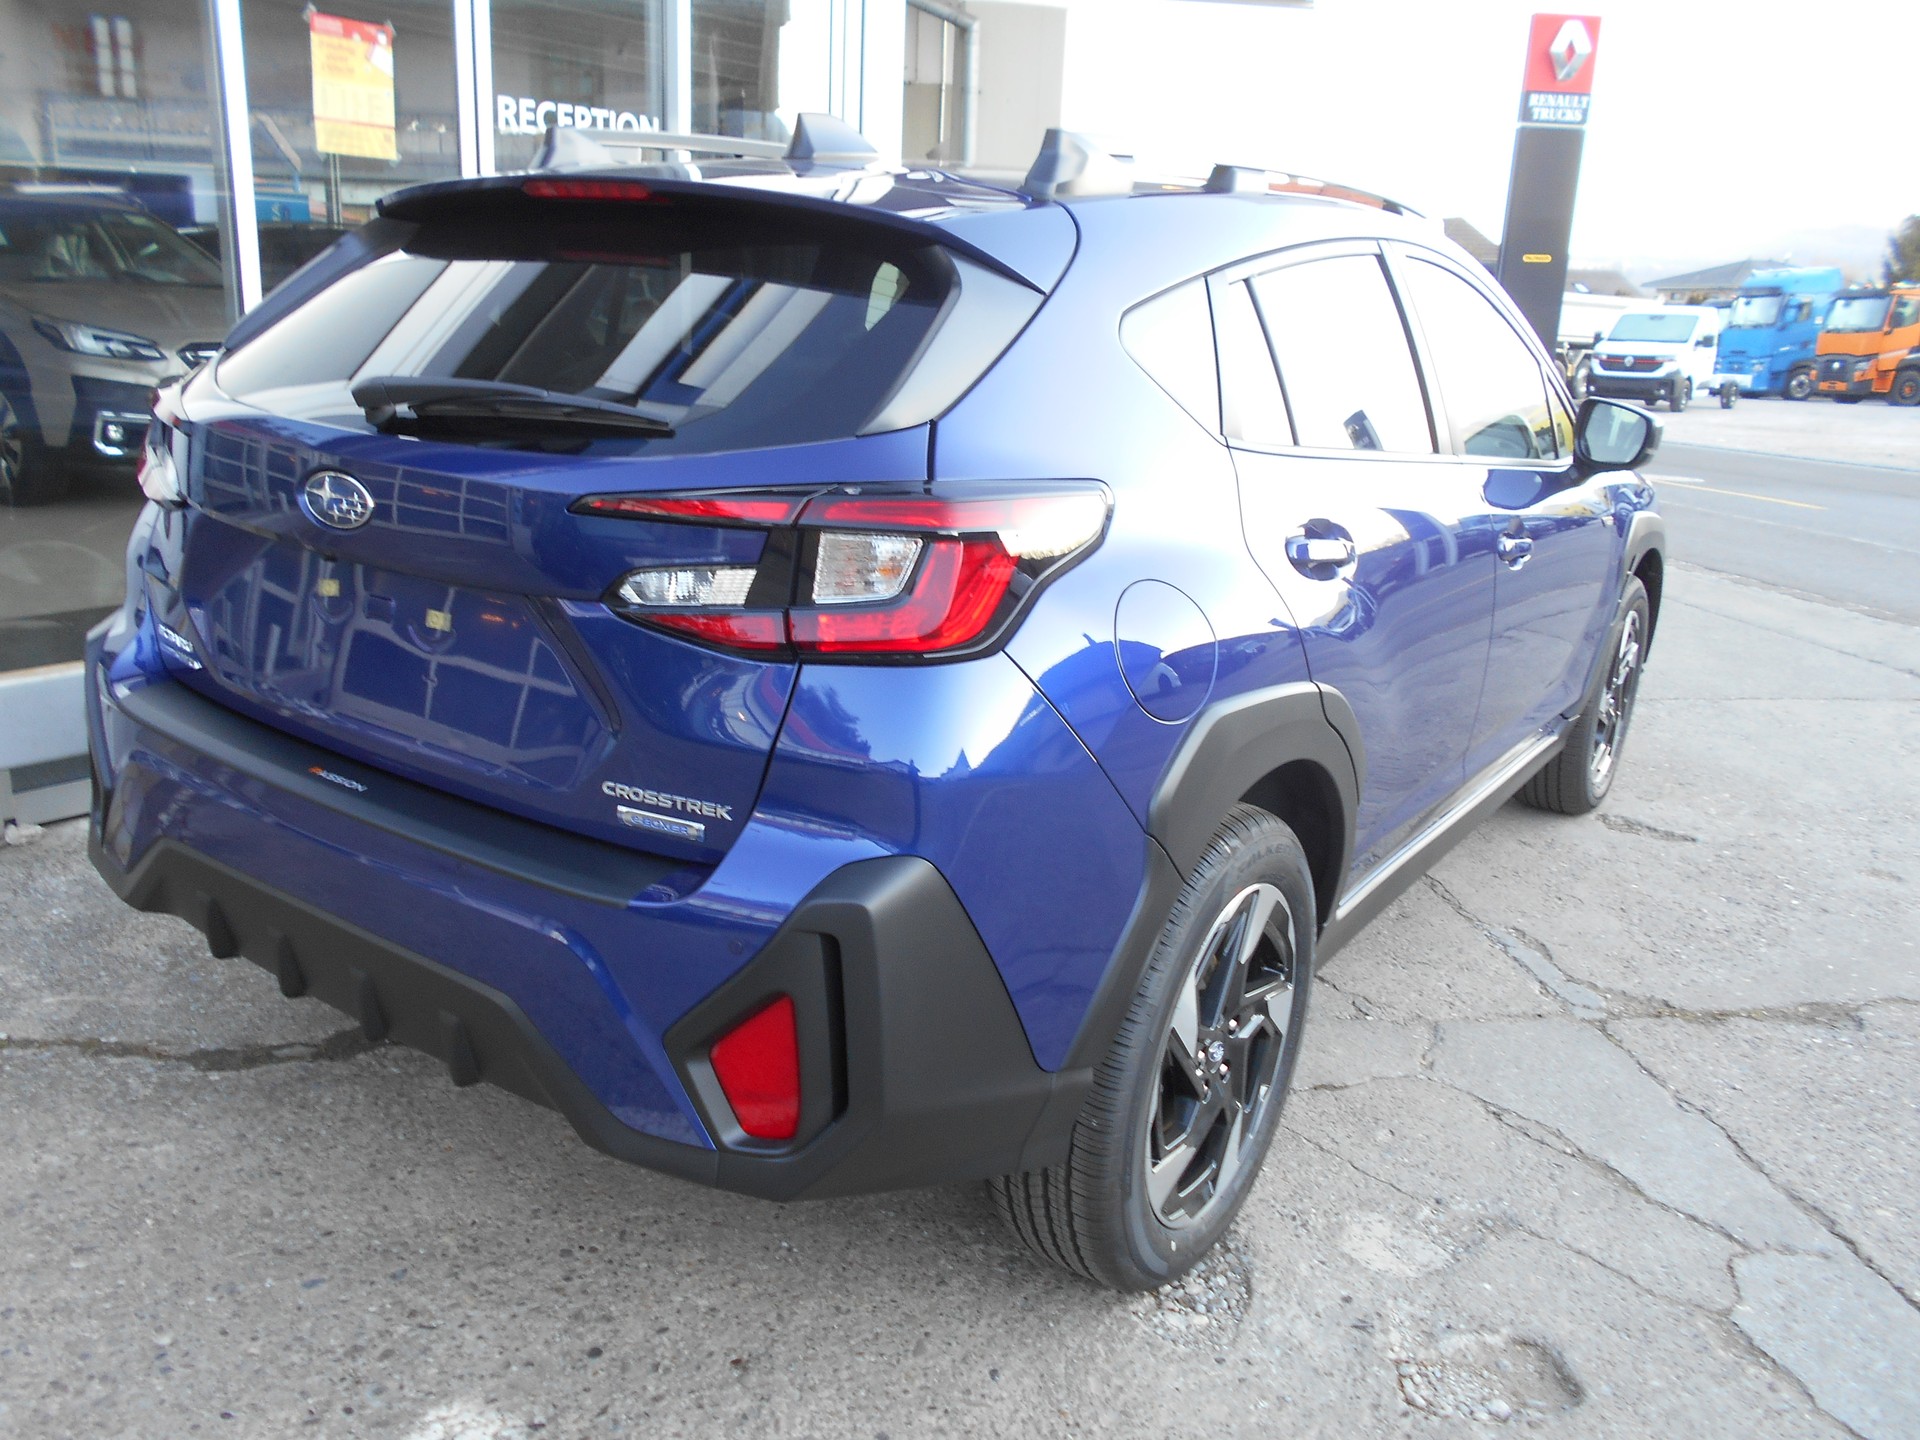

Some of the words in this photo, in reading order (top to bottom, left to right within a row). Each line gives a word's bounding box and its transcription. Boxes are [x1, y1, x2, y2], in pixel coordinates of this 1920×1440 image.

[497, 94, 660, 135] RECEPTION
[1528, 93, 1590, 108] RENAULT
[1531, 107, 1583, 122] TRUCKS
[602, 780, 733, 821] CROSSTREK
